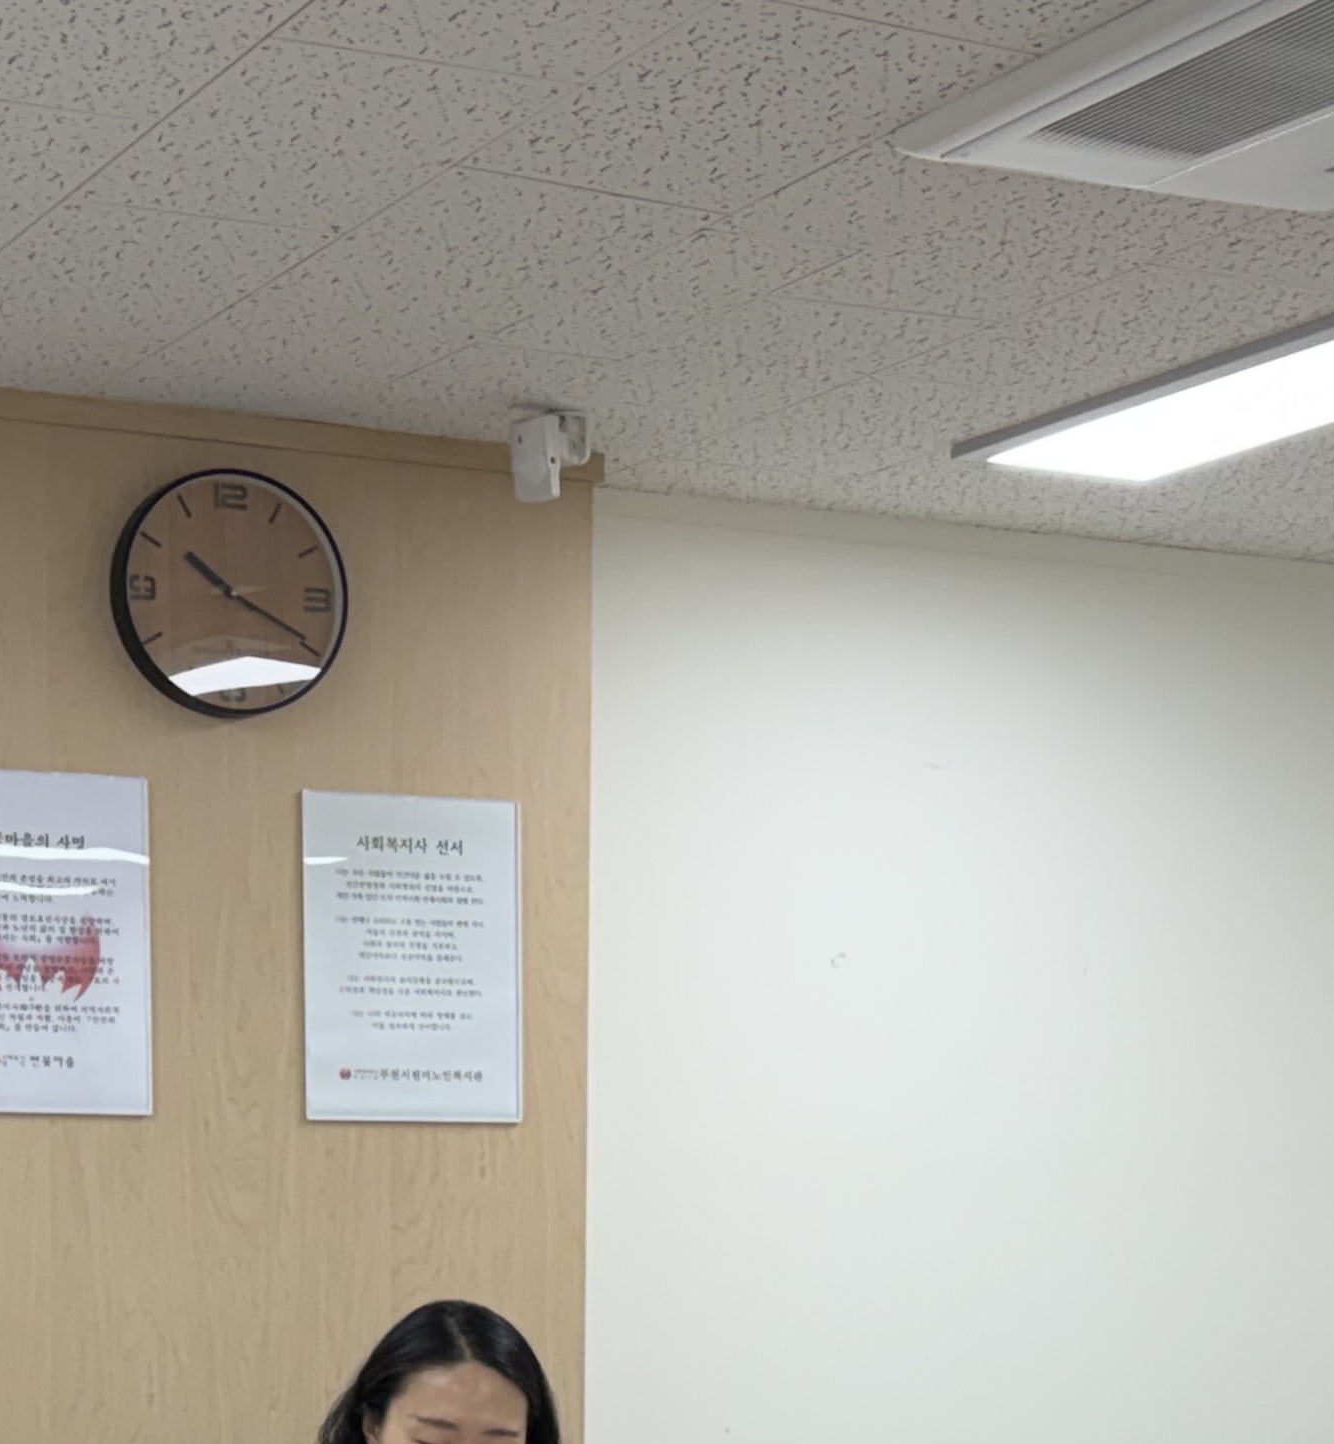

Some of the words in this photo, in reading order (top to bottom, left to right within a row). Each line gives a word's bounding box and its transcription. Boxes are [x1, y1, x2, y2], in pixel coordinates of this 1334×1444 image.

[214, 481, 247, 510] 12
[304, 587, 331, 614] 3
[357, 835, 428, 854] 사회복지사
[436, 839, 463, 856] 선서
